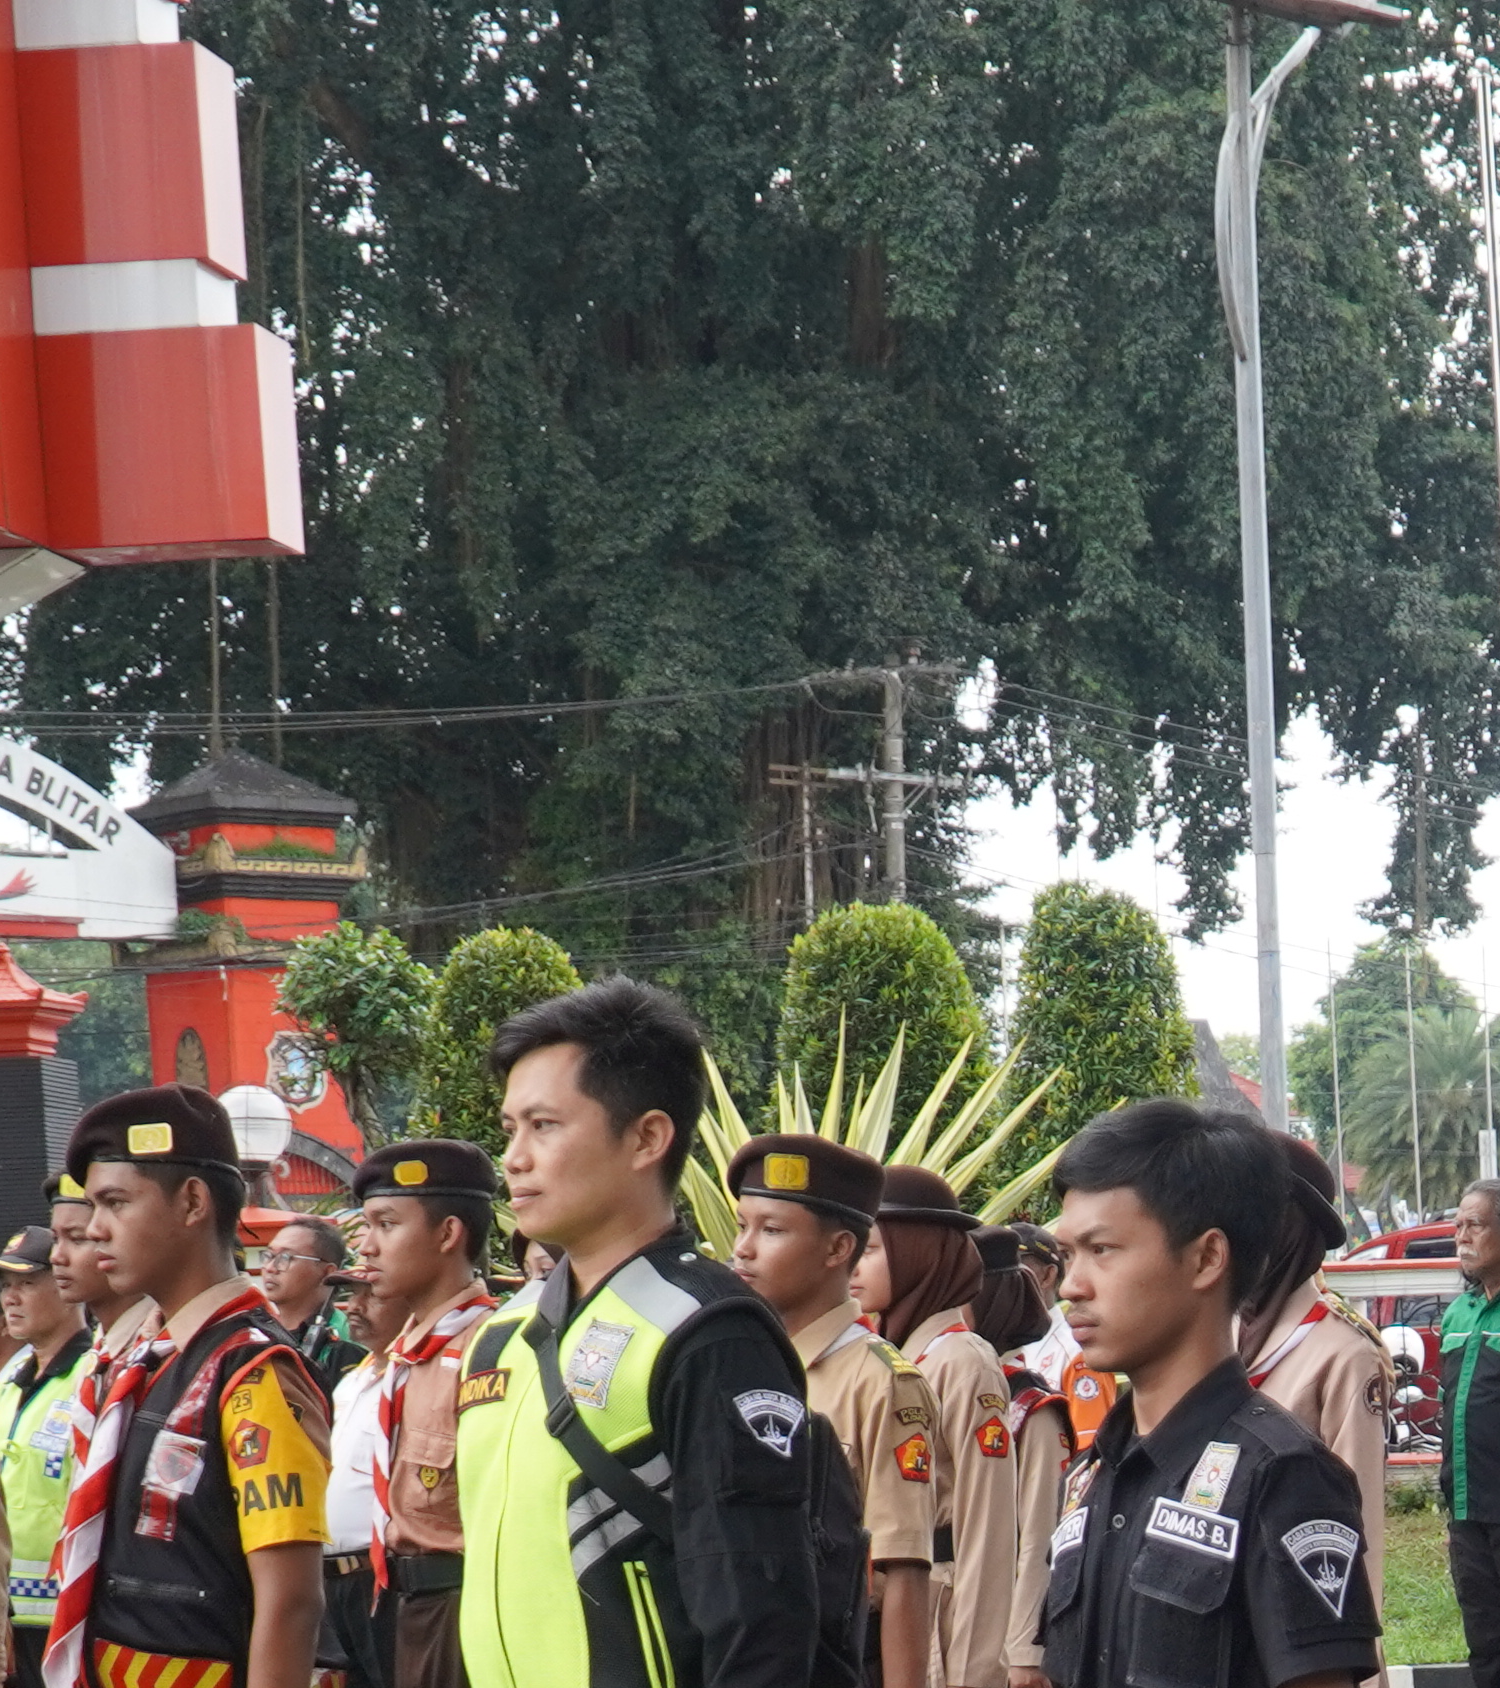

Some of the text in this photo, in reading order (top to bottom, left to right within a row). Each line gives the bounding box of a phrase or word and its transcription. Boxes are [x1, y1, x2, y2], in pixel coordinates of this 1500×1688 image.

[25, 768, 121, 846] BLITAR
[234, 1394, 251, 1410] 25
[1157, 1508, 1207, 1540] DIMAS
